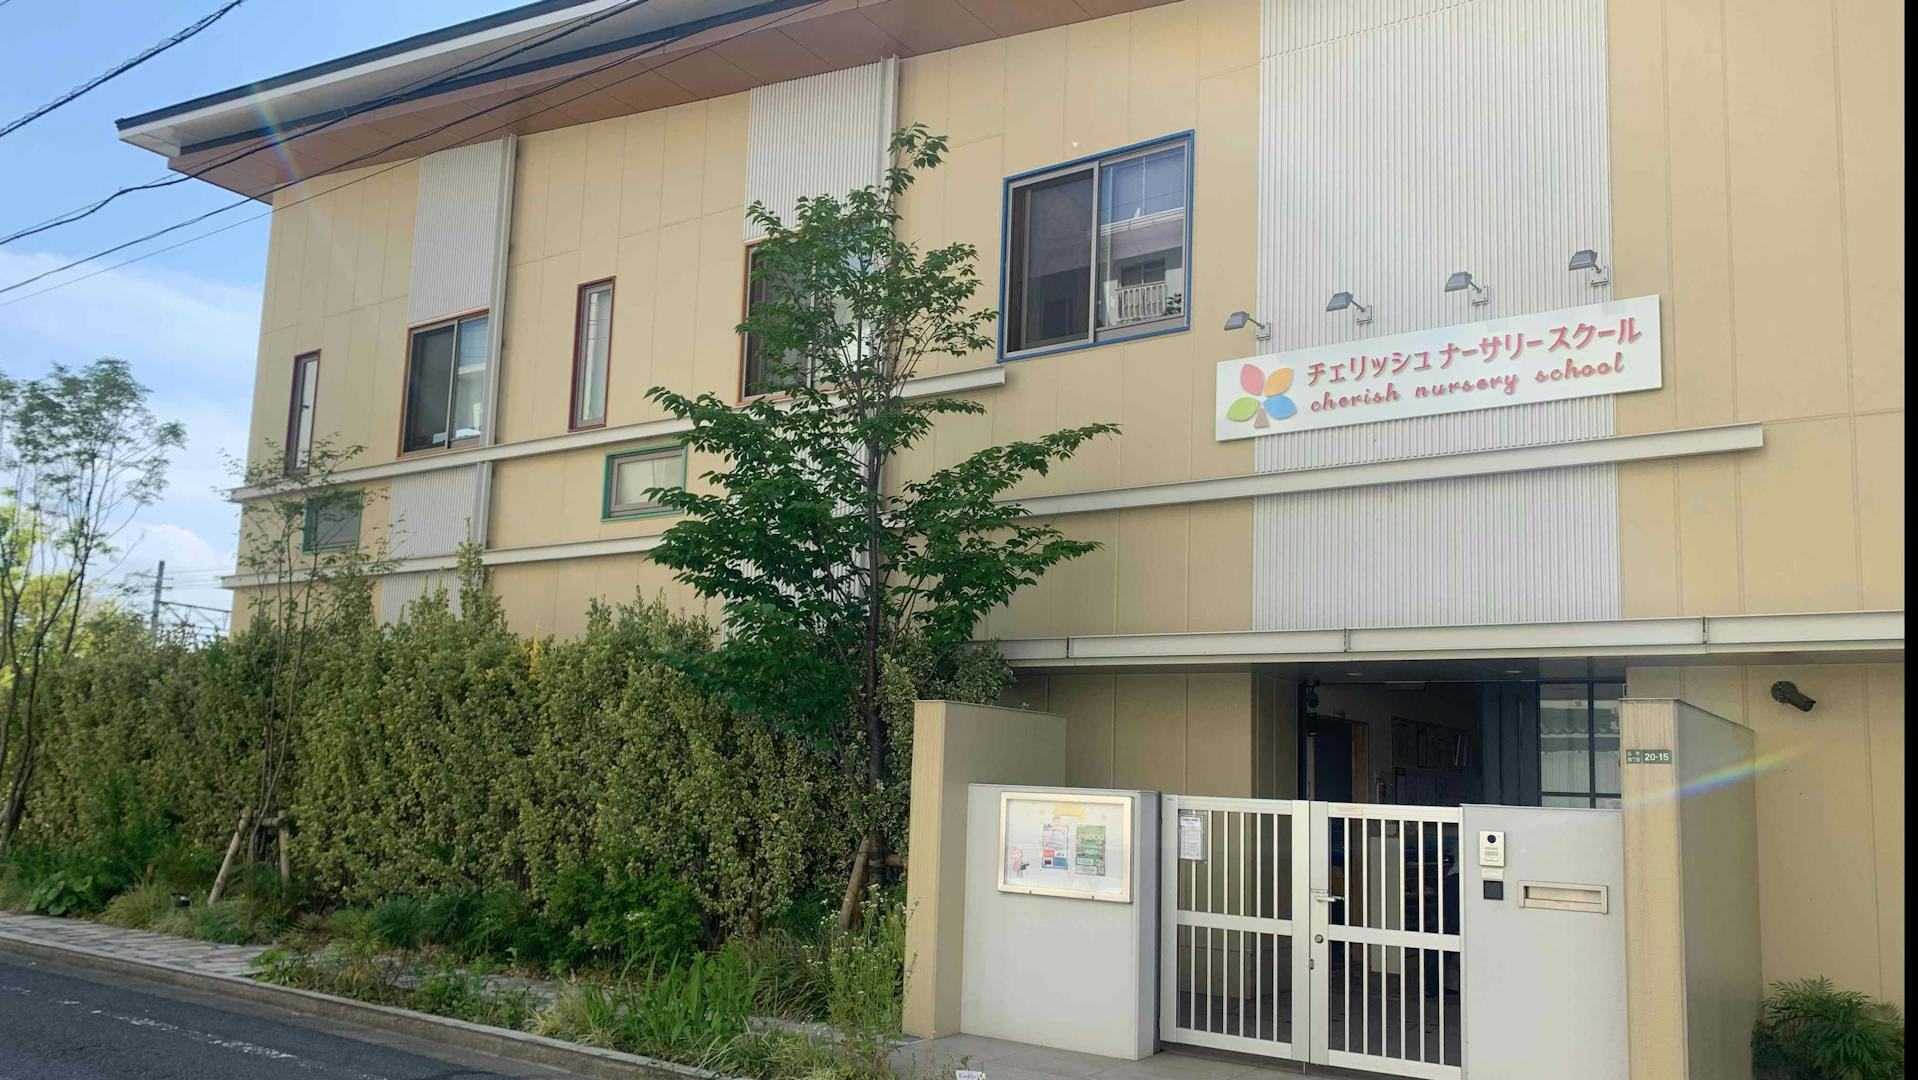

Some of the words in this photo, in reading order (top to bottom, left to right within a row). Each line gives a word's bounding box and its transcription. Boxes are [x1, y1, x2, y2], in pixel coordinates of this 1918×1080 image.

[1307, 351, 1432, 387] チェリッシュ
[1310, 382, 1400, 412] cherish
[1415, 373, 1519, 399] nursery
[1536, 352, 1625, 383] school
[1644, 752, 1670, 761] 20-15
